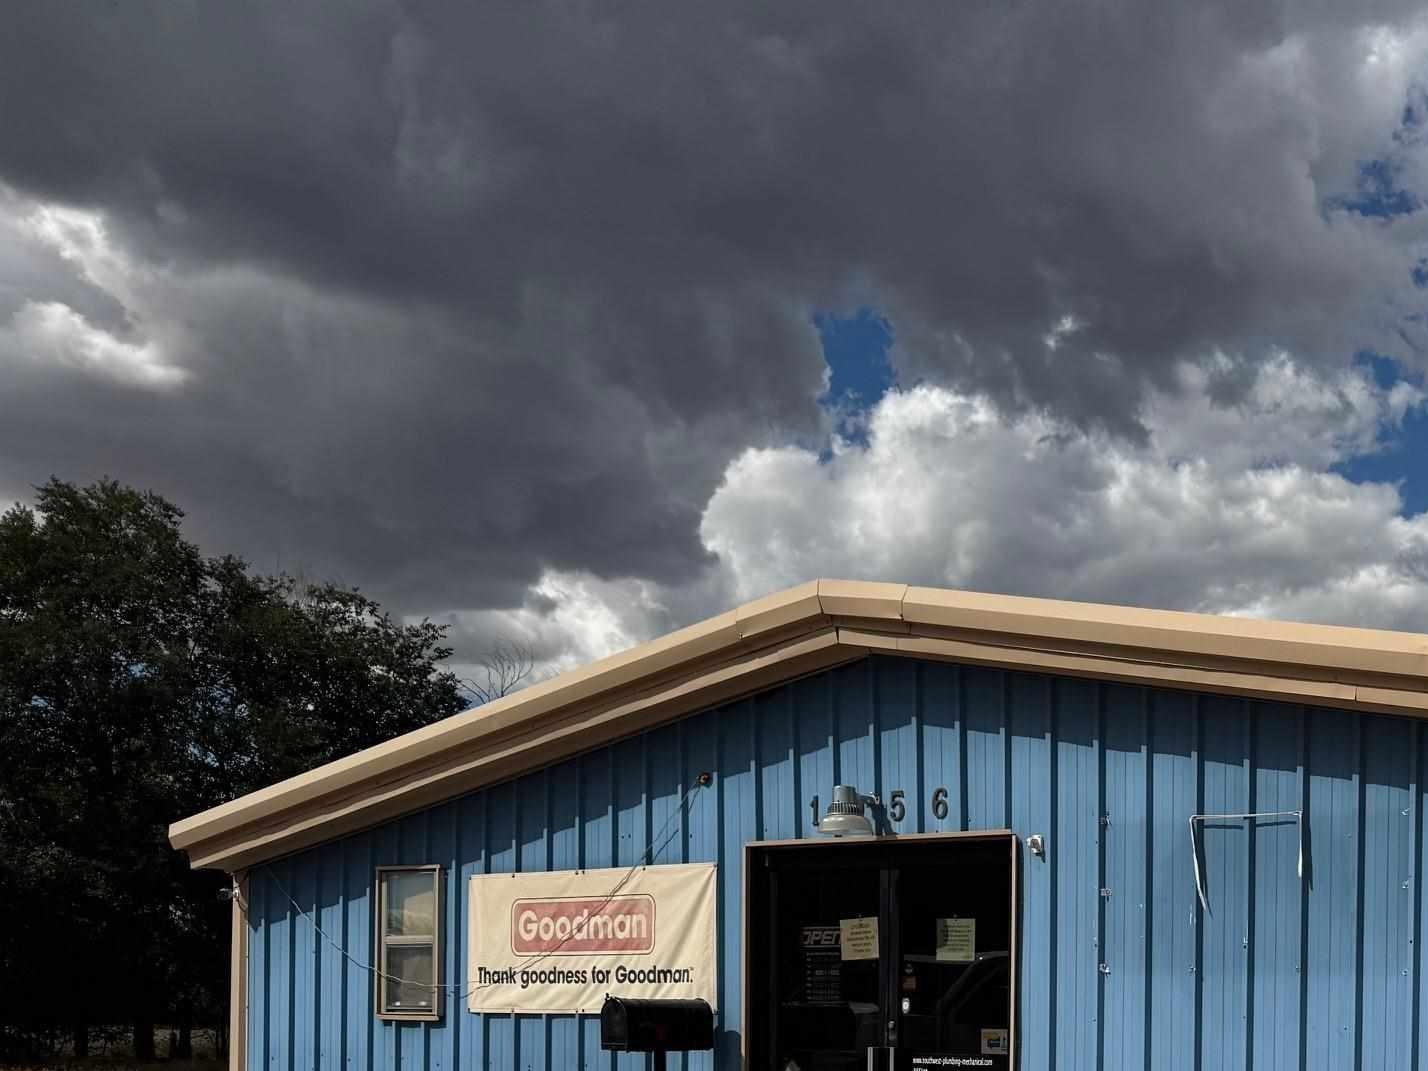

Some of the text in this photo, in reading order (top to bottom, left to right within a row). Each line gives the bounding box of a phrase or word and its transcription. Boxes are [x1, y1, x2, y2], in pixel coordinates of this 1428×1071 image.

[809, 787, 949, 826] 156
[518, 909, 648, 942] Goodman
[477, 966, 517, 985] Thank
[520, 967, 587, 989] goodness
[591, 965, 611, 984] for
